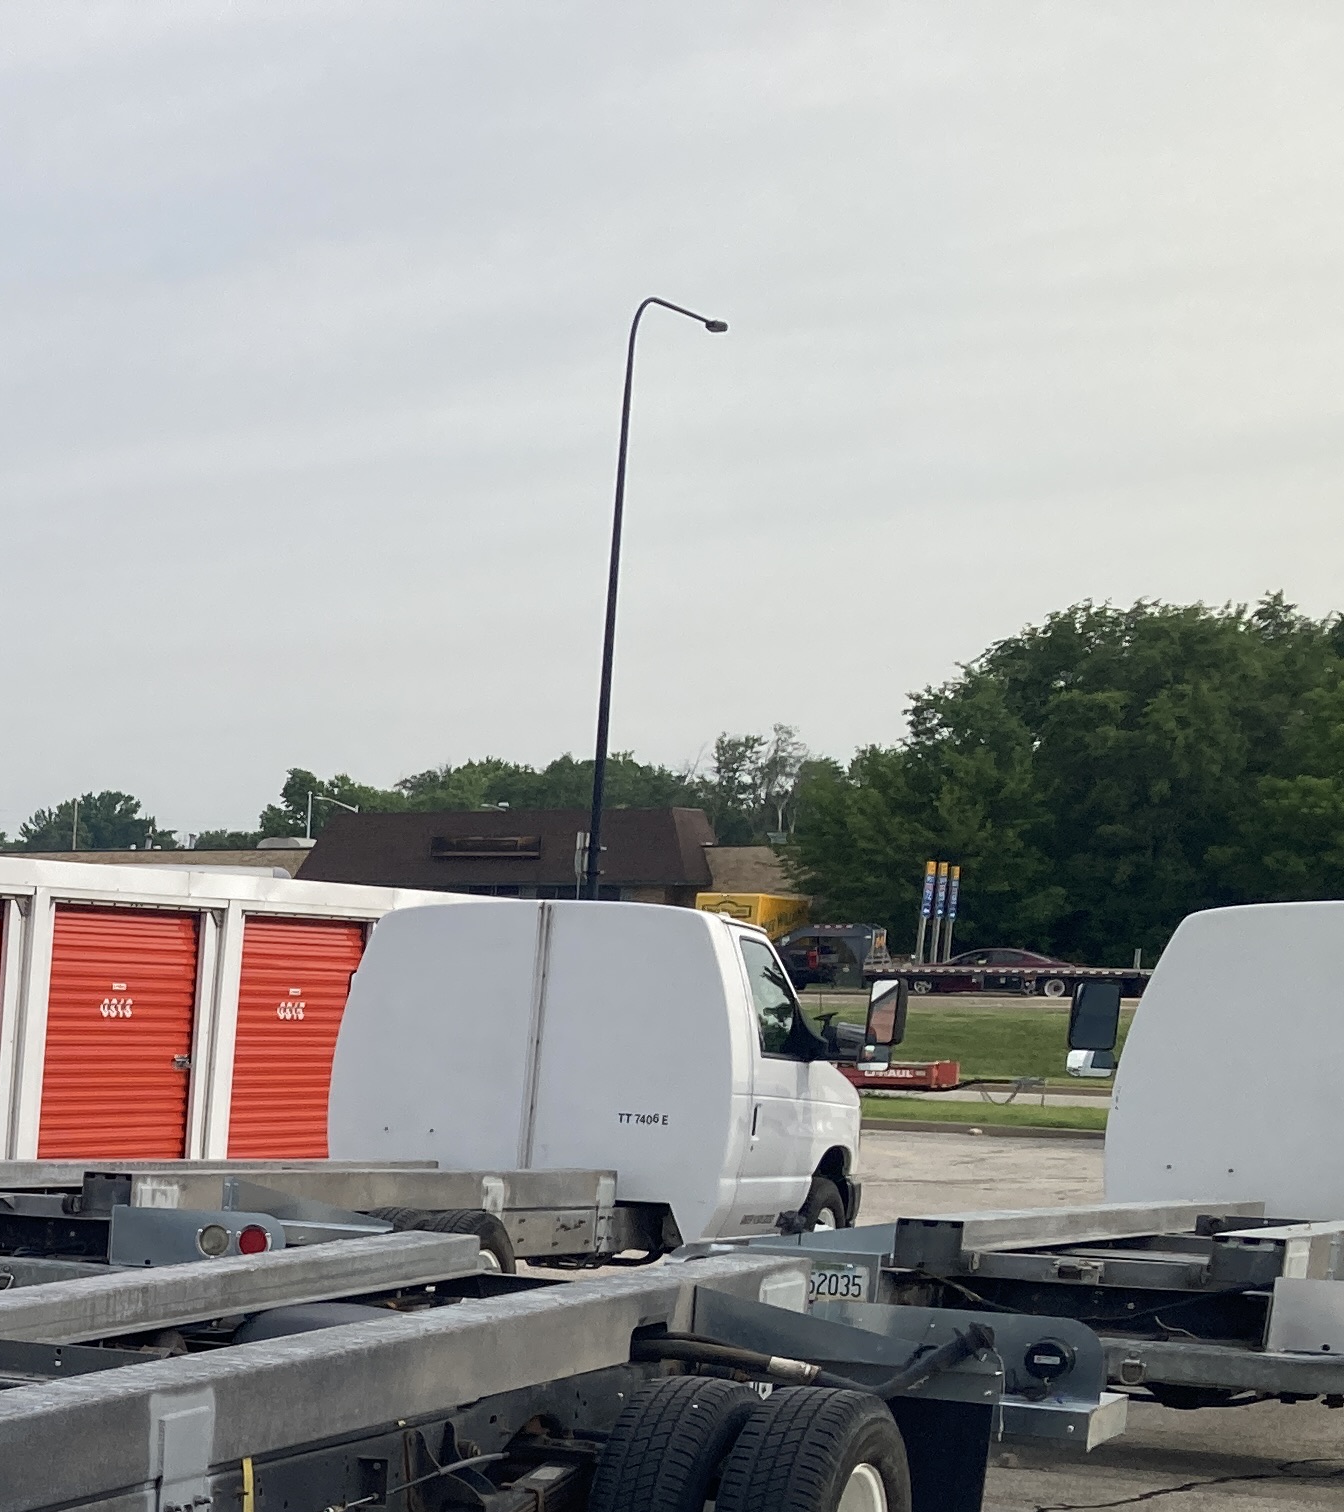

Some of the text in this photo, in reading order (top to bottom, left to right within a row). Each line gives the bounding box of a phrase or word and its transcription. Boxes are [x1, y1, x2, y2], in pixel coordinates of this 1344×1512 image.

[618, 1113, 669, 1126] TT 7406 E
